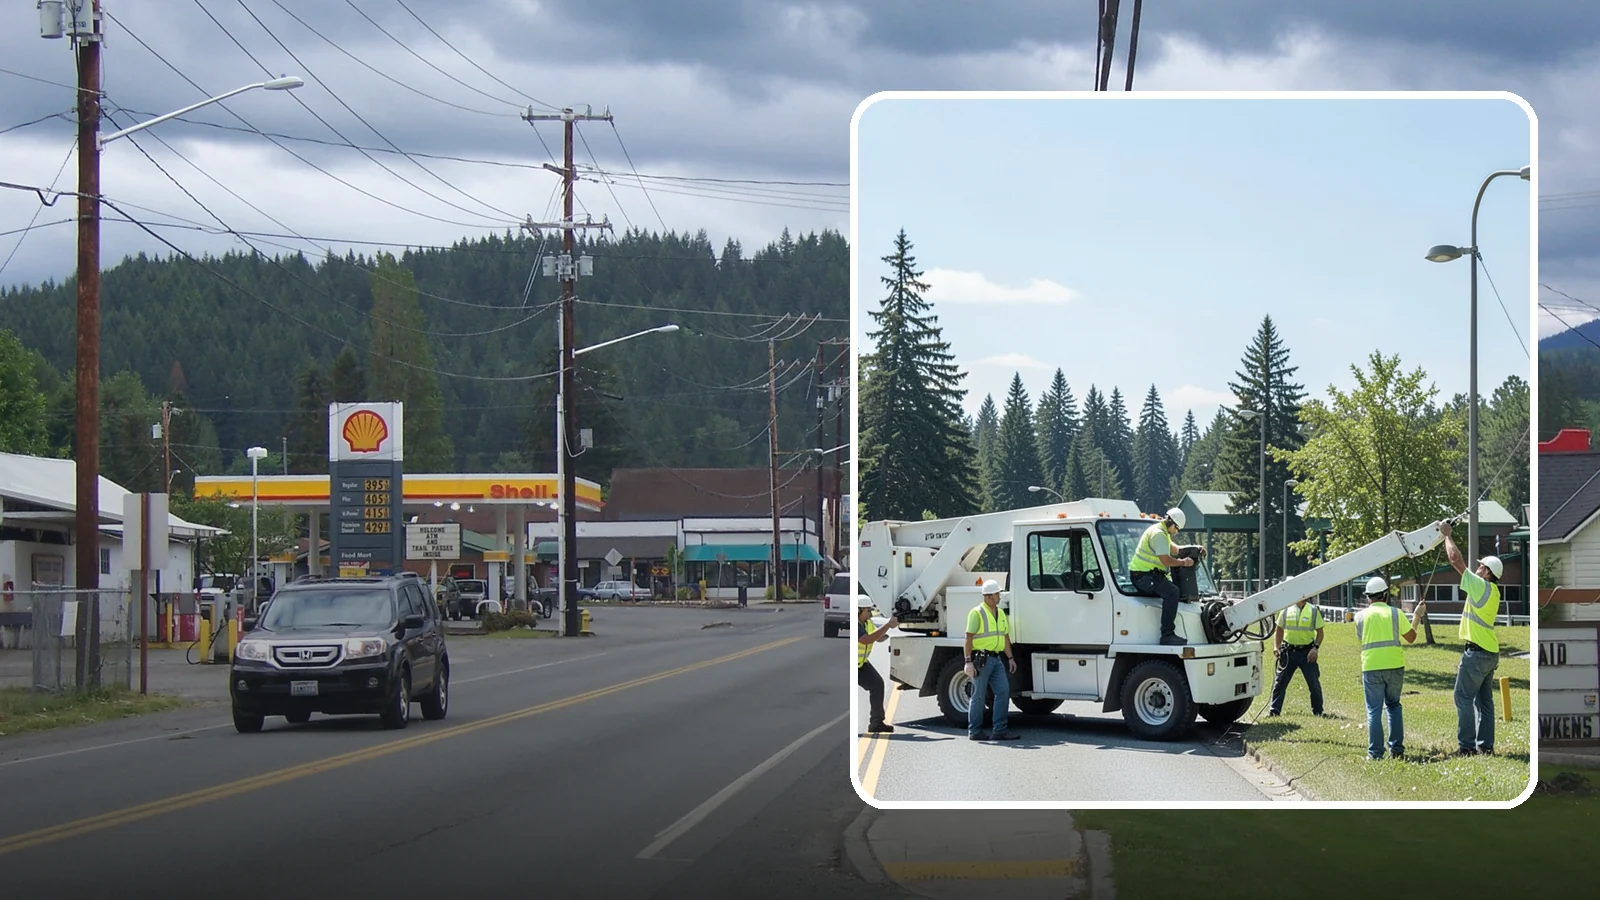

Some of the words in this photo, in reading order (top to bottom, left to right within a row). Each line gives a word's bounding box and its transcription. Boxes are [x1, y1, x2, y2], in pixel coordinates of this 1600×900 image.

[365, 480, 383, 490] 395
[490, 484, 547, 498] Shell
[365, 494, 383, 504] 405
[365, 508, 383, 518] 415
[366, 522, 383, 532] 429
